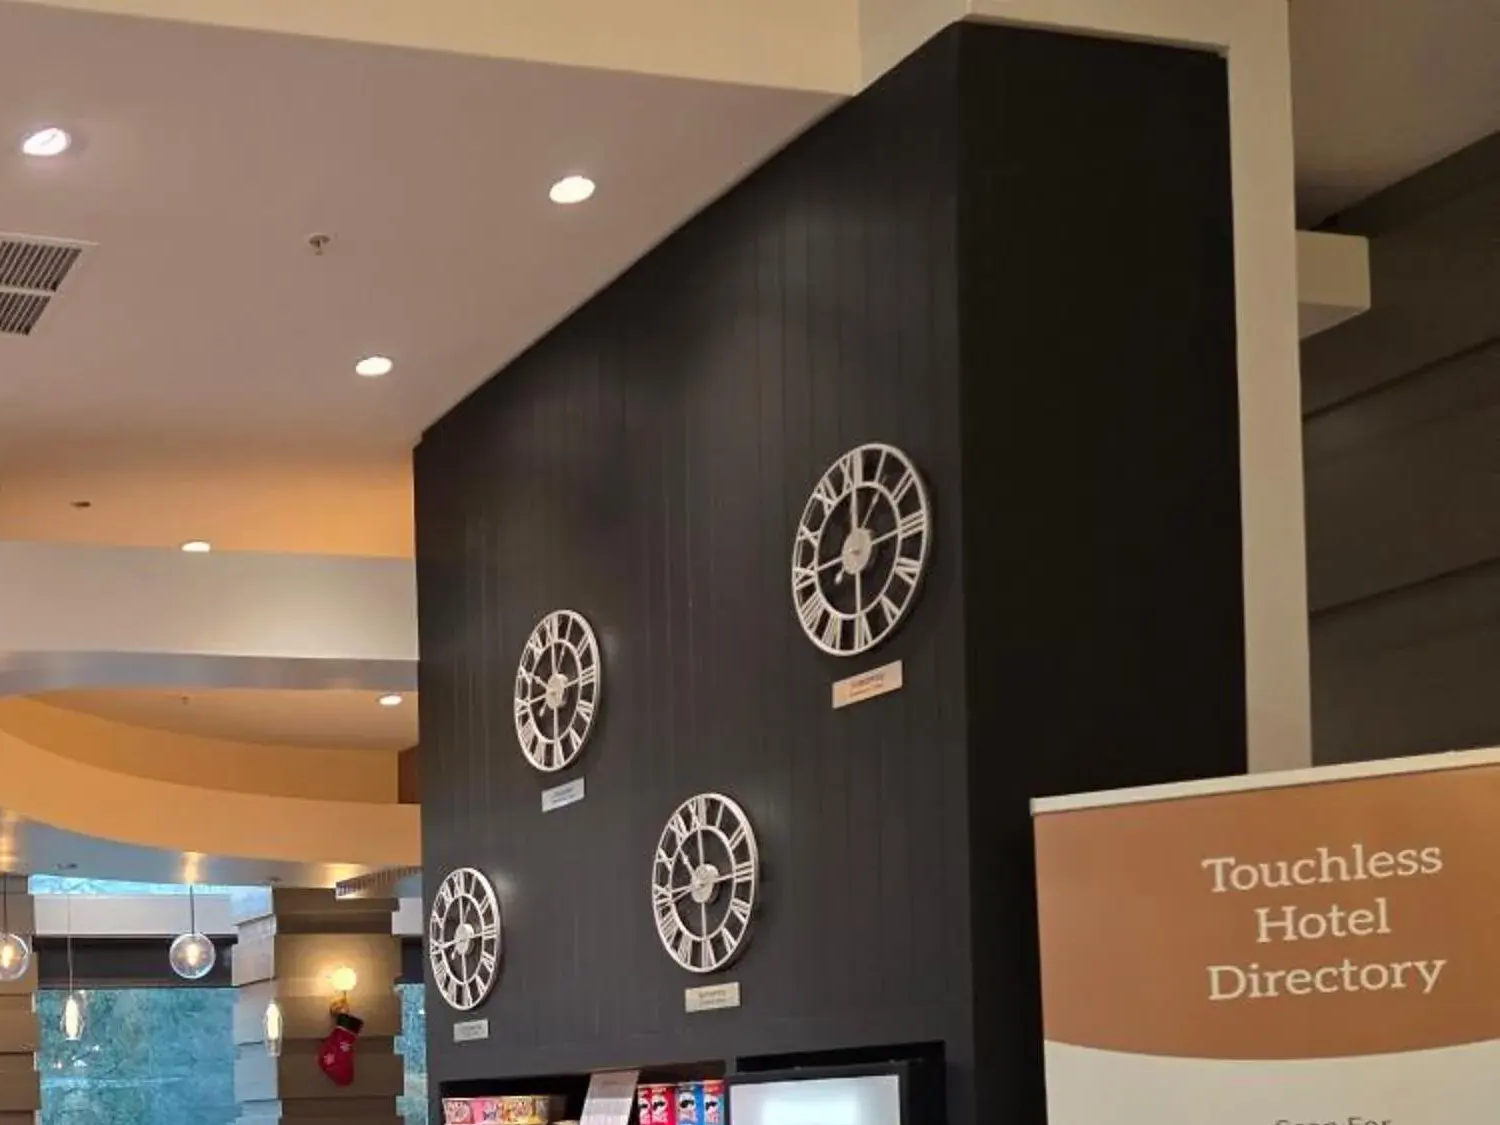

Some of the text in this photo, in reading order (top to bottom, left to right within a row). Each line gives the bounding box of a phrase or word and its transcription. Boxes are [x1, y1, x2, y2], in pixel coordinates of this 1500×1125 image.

[1201, 843, 1444, 893] Touchless
[1255, 898, 1392, 943] Hotel
[1206, 957, 1447, 1001] Directory
